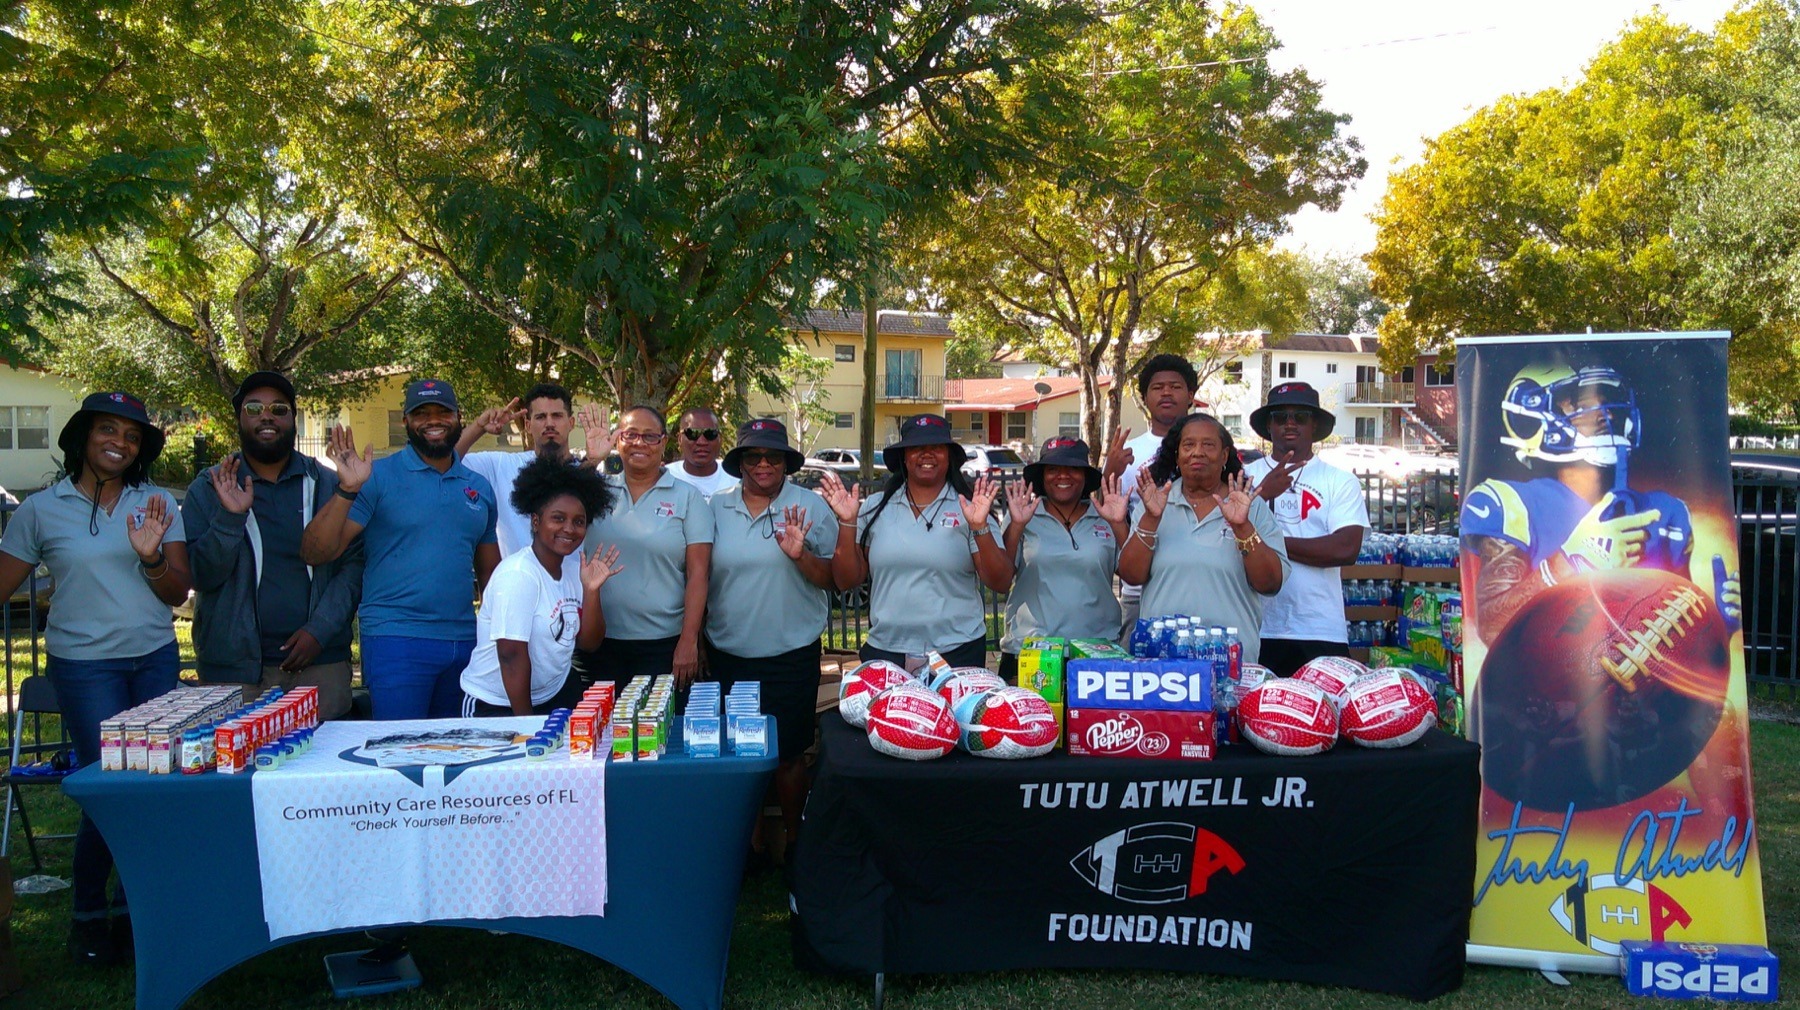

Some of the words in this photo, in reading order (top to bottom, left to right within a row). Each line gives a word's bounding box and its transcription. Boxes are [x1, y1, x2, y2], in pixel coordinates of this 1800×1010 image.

[1077, 670, 1201, 702] PEPSI
[1070, 709, 1079, 717] 12
[693, 727, 716, 735] Refresh
[738, 726, 762, 734] Refresh
[1091, 722, 1139, 750] Pepper
[1106, 719, 1126, 733] Dr
[1146, 737, 1160, 749] 23
[1181, 750, 1210, 758] FANSVILLE
[1019, 782, 1109, 808] TUTU
[1119, 778, 1248, 808] ATWELL
[1261, 777, 1314, 808] JR.
[282, 798, 392, 821] Community
[396, 796, 437, 811] Care
[441, 793, 532, 809] Resources
[536, 789, 556, 805] of
[559, 789, 579, 804] FL
[403, 814, 456, 828] Yourself
[1188, 826, 1247, 898] A
[1048, 913, 1252, 951] FOUNDATION
[1641, 961, 1770, 995] PEPSI
